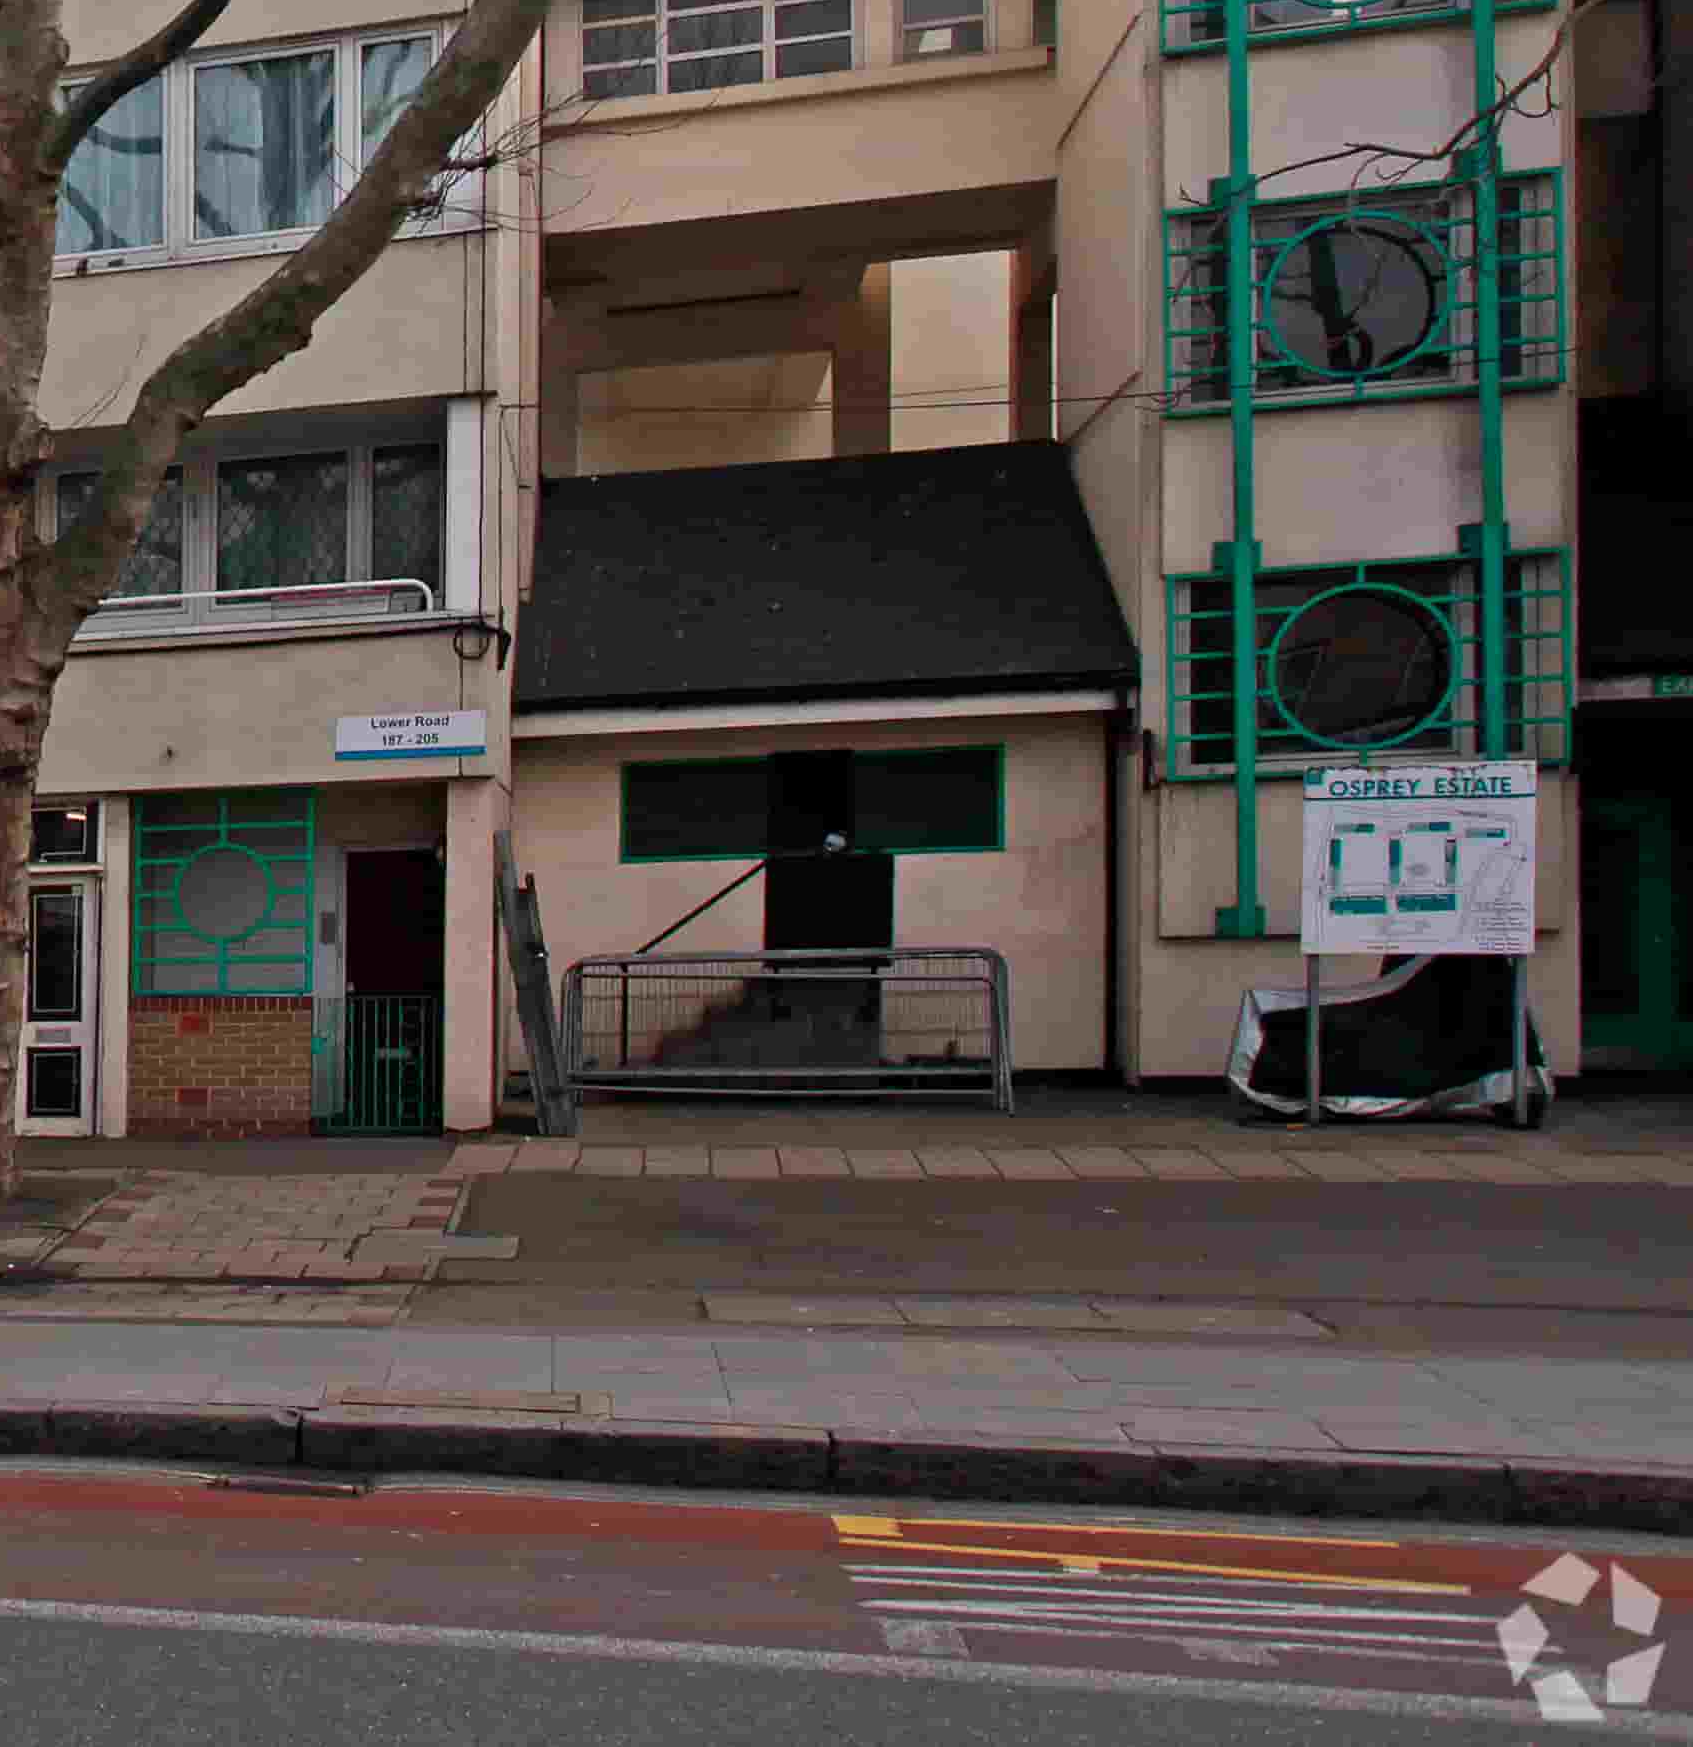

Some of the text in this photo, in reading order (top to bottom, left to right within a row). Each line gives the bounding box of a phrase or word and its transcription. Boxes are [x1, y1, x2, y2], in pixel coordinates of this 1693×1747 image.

[370, 715, 450, 729] Lower Road
[382, 735, 402, 746] 187
[416, 733, 439, 745] 205
[1329, 776, 1512, 797] OSPREY ESTATE
